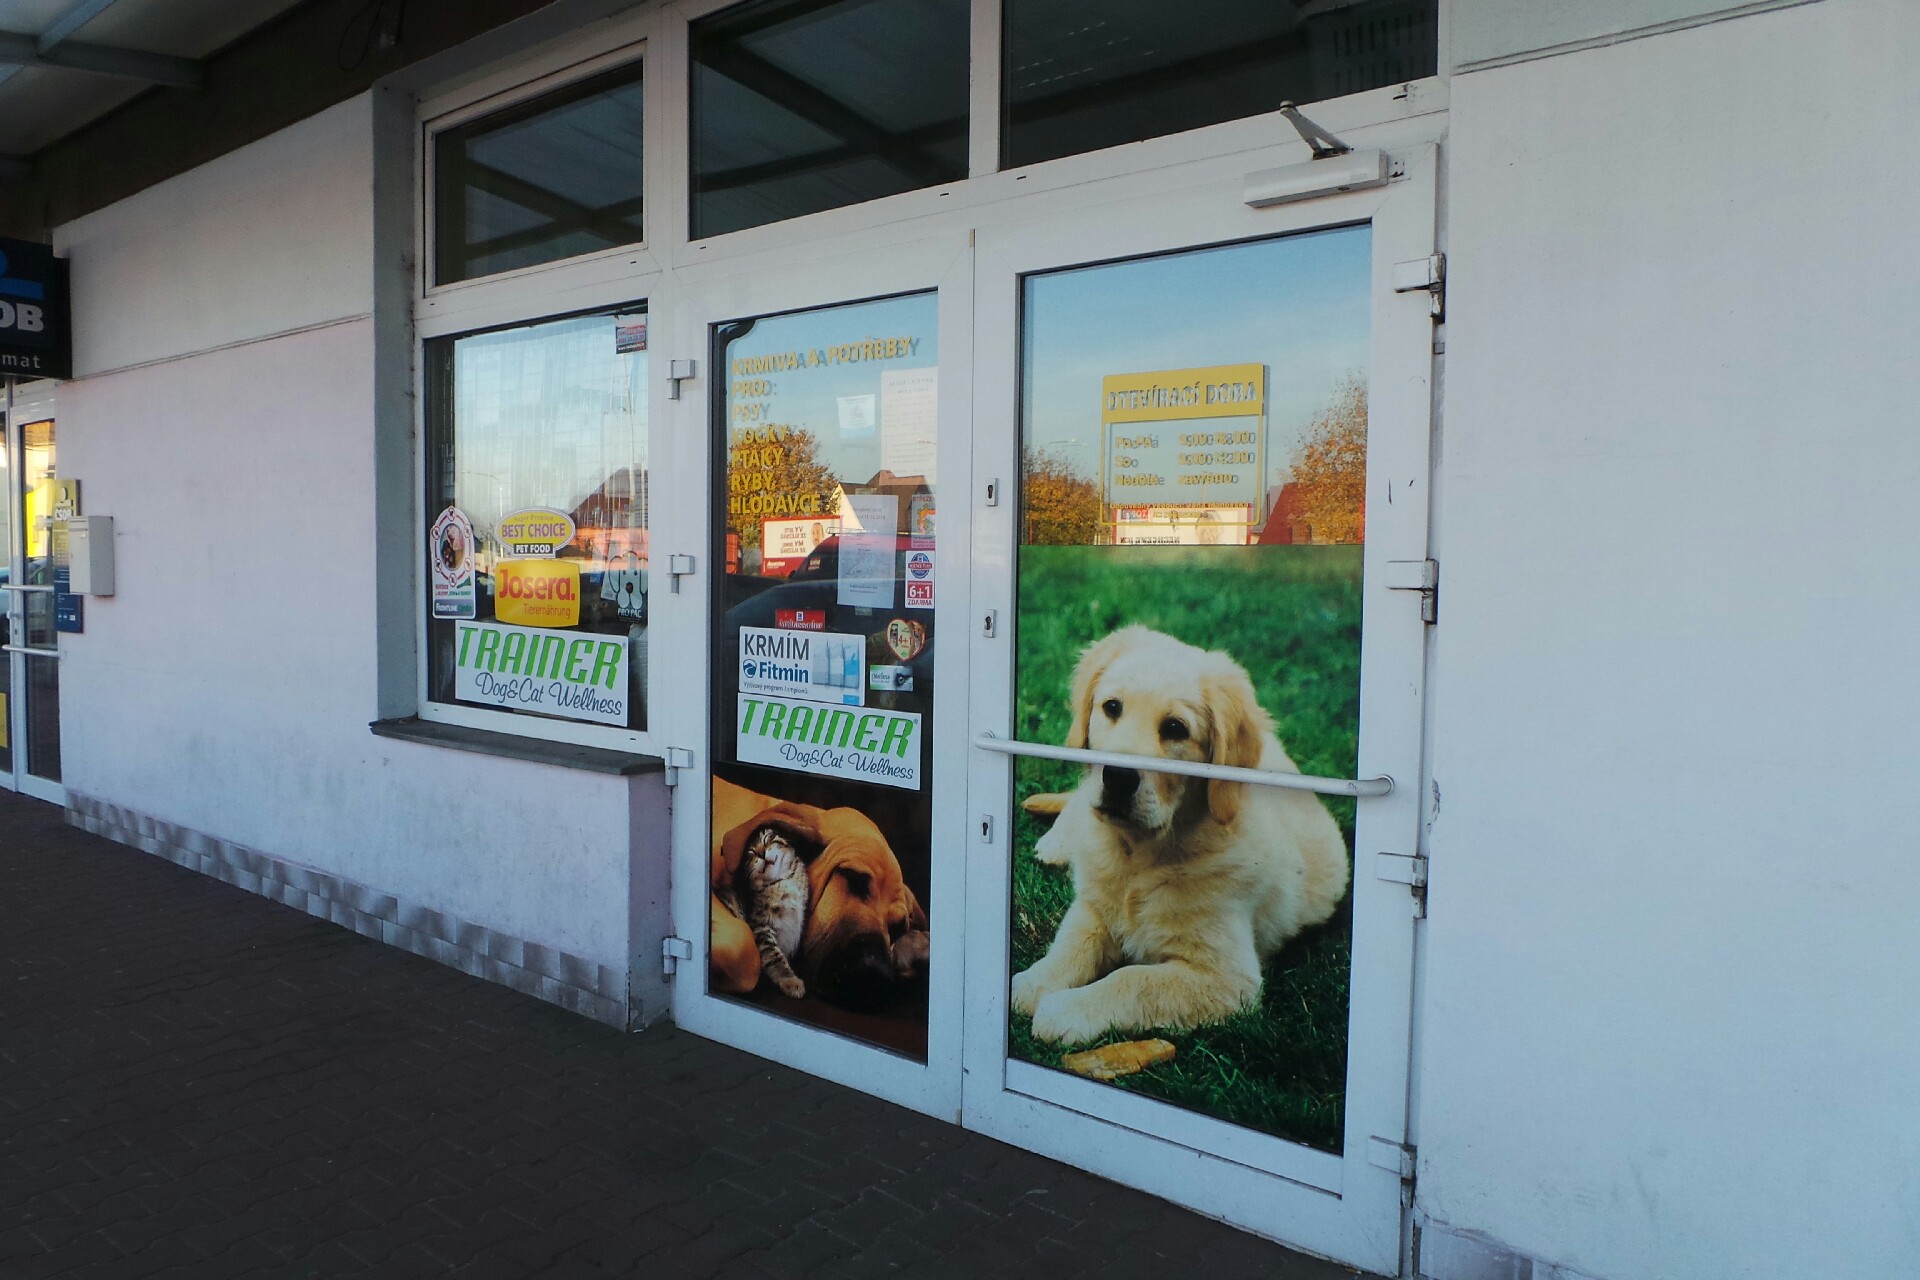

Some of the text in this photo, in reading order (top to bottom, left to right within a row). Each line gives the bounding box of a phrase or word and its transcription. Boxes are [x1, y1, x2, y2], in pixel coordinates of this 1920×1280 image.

[732, 335, 914, 376] KRMIVA A POTŘEBY
[1106, 381, 1257, 411] OTEVÍRACÍ DOBA
[732, 403, 763, 421] PSY
[732, 423, 790, 445] KOČKY
[731, 471, 774, 491] RYBY
[730, 493, 821, 513] HLODAVCE
[502, 523, 566, 538] BEST CHOICE
[516, 544, 551, 553] PET FOOD
[909, 586, 930, 598] 6+1
[523, 603, 571, 619] Tierernährung
[744, 632, 810, 661] KRMÍM
[458, 626, 623, 690] TRAINER
[759, 661, 809, 683] Fitmin
[475, 672, 622, 716] Dog&Cat Wellness
[764, 684, 784, 692] program
[741, 699, 914, 759] TRAINER
[780, 743, 914, 780] Dog&Cat Wellness
